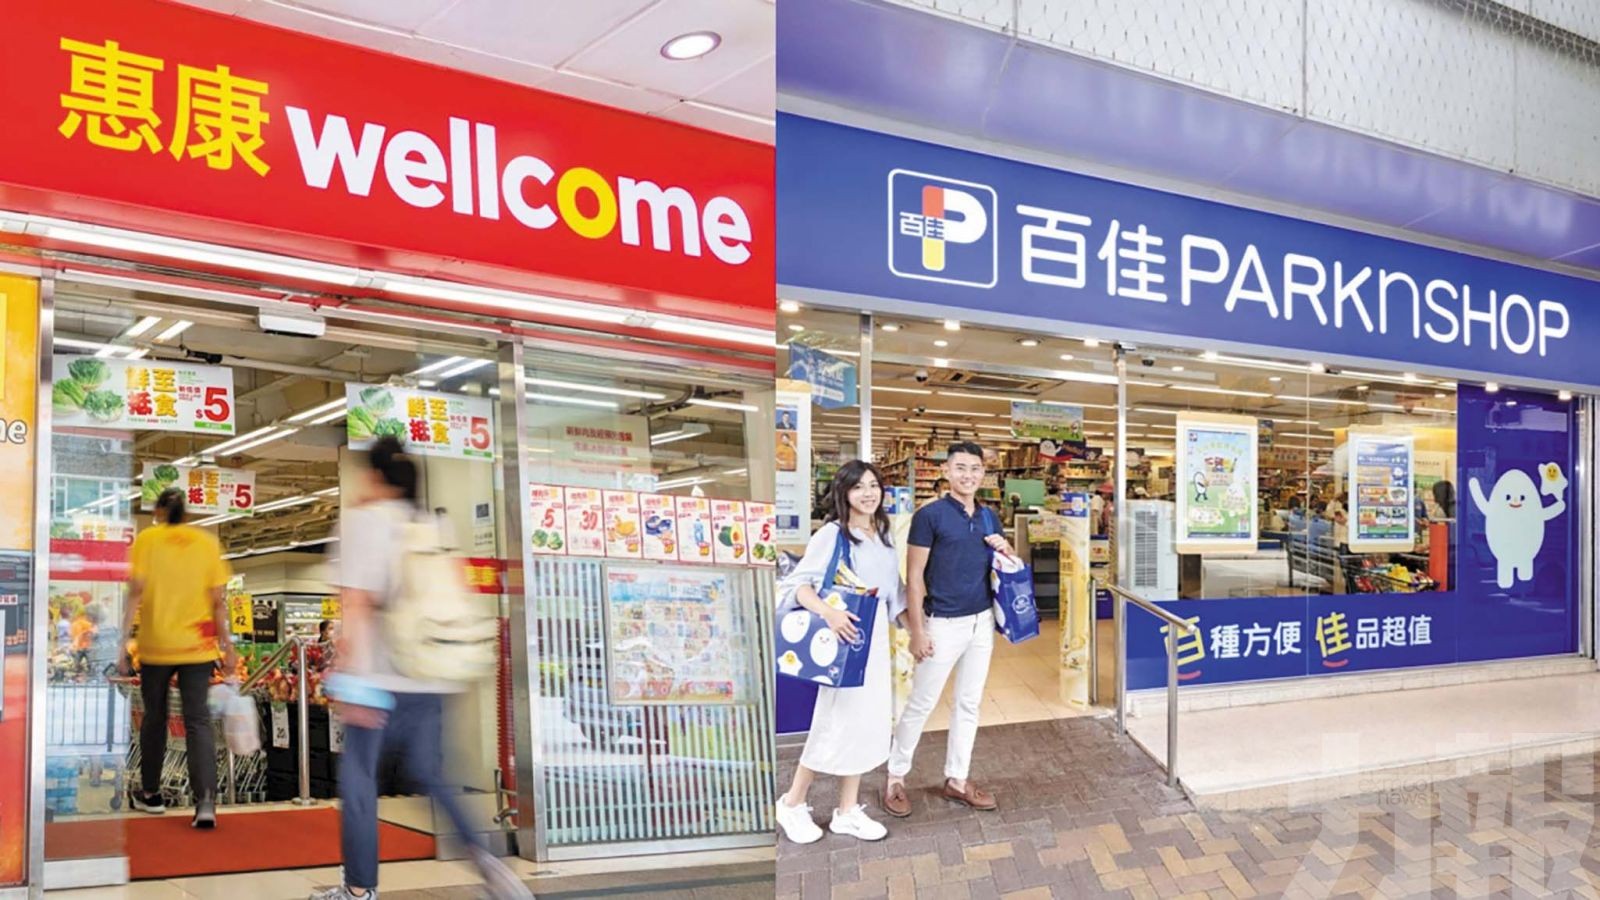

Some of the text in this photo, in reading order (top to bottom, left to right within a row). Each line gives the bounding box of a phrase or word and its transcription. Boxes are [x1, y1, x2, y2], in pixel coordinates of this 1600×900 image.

[59, 37, 271, 177] 惠康
[285, 105, 752, 265] wellcome
[1016, 204, 1168, 303] 百佳
[1160, 611, 1432, 667] 百種方便 佳品超值
